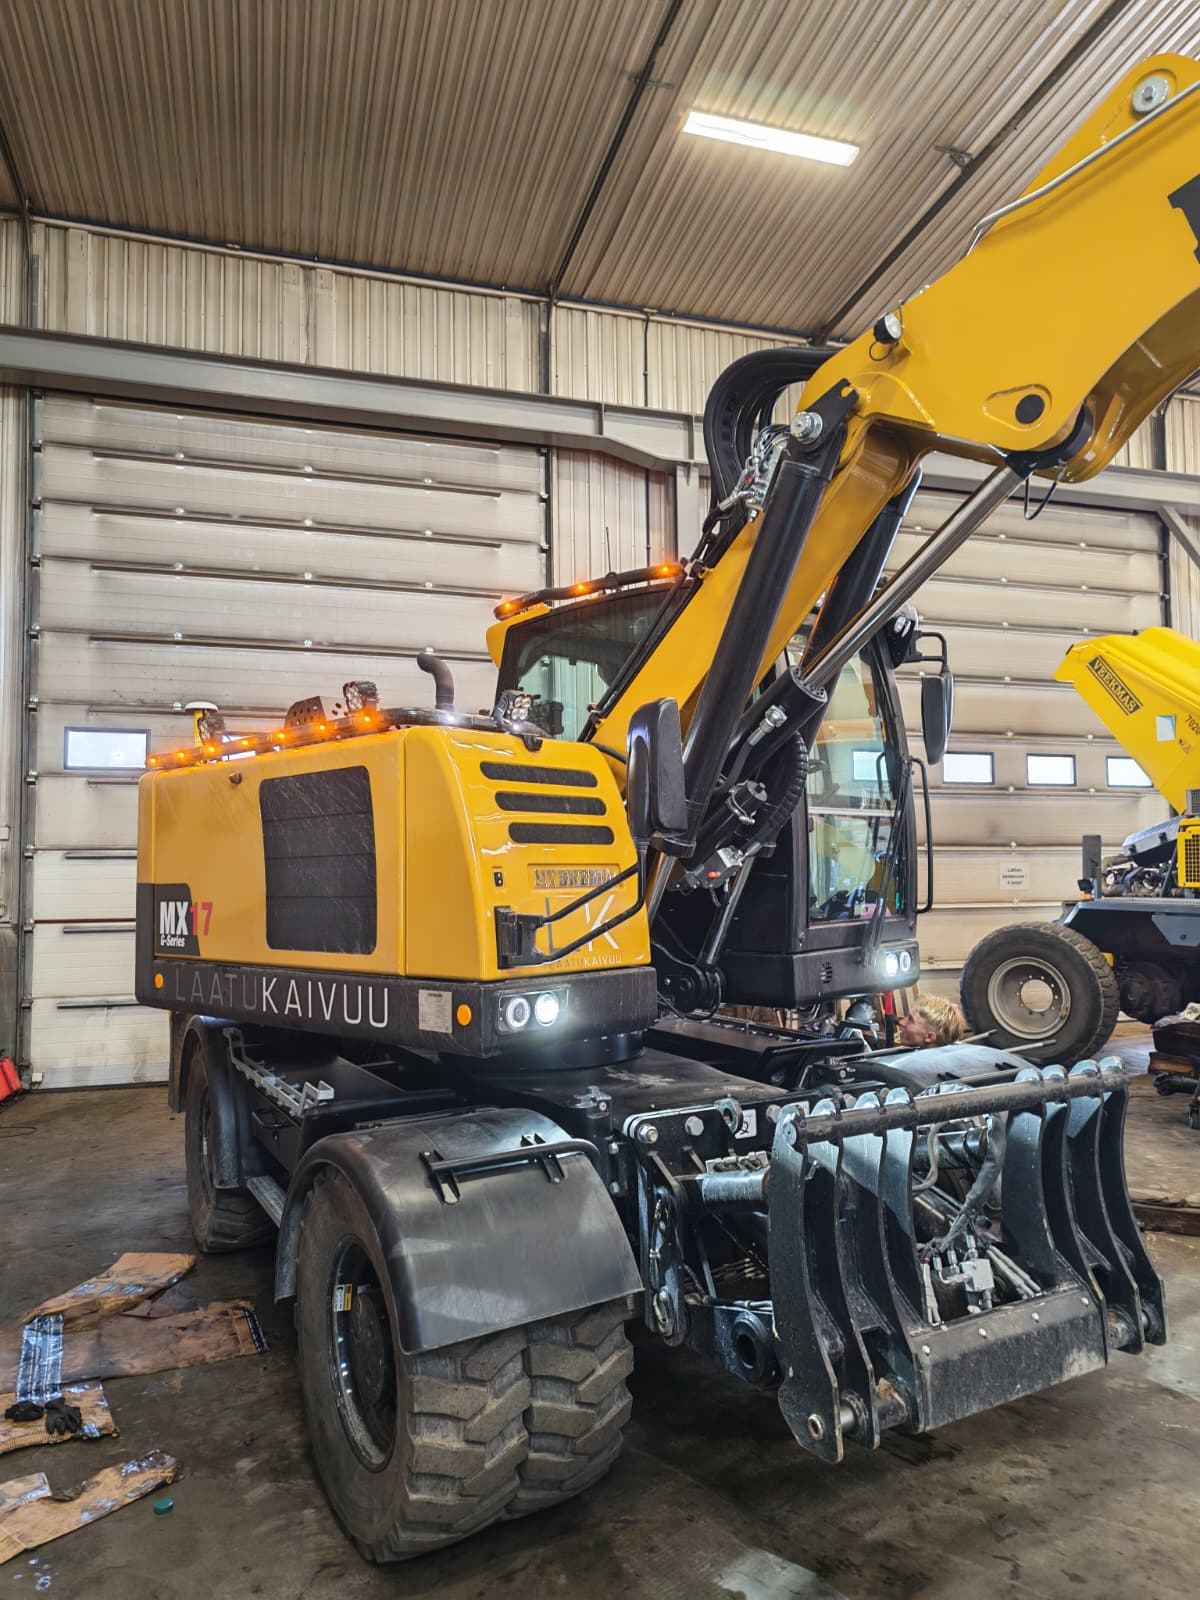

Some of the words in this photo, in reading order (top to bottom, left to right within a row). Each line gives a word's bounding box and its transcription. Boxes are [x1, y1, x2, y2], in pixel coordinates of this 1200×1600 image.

[1093, 660, 1136, 711] VEEKMAS
[160, 935, 185, 948] G-Series
[175, 967, 389, 1028] LAATUKAIVUU
